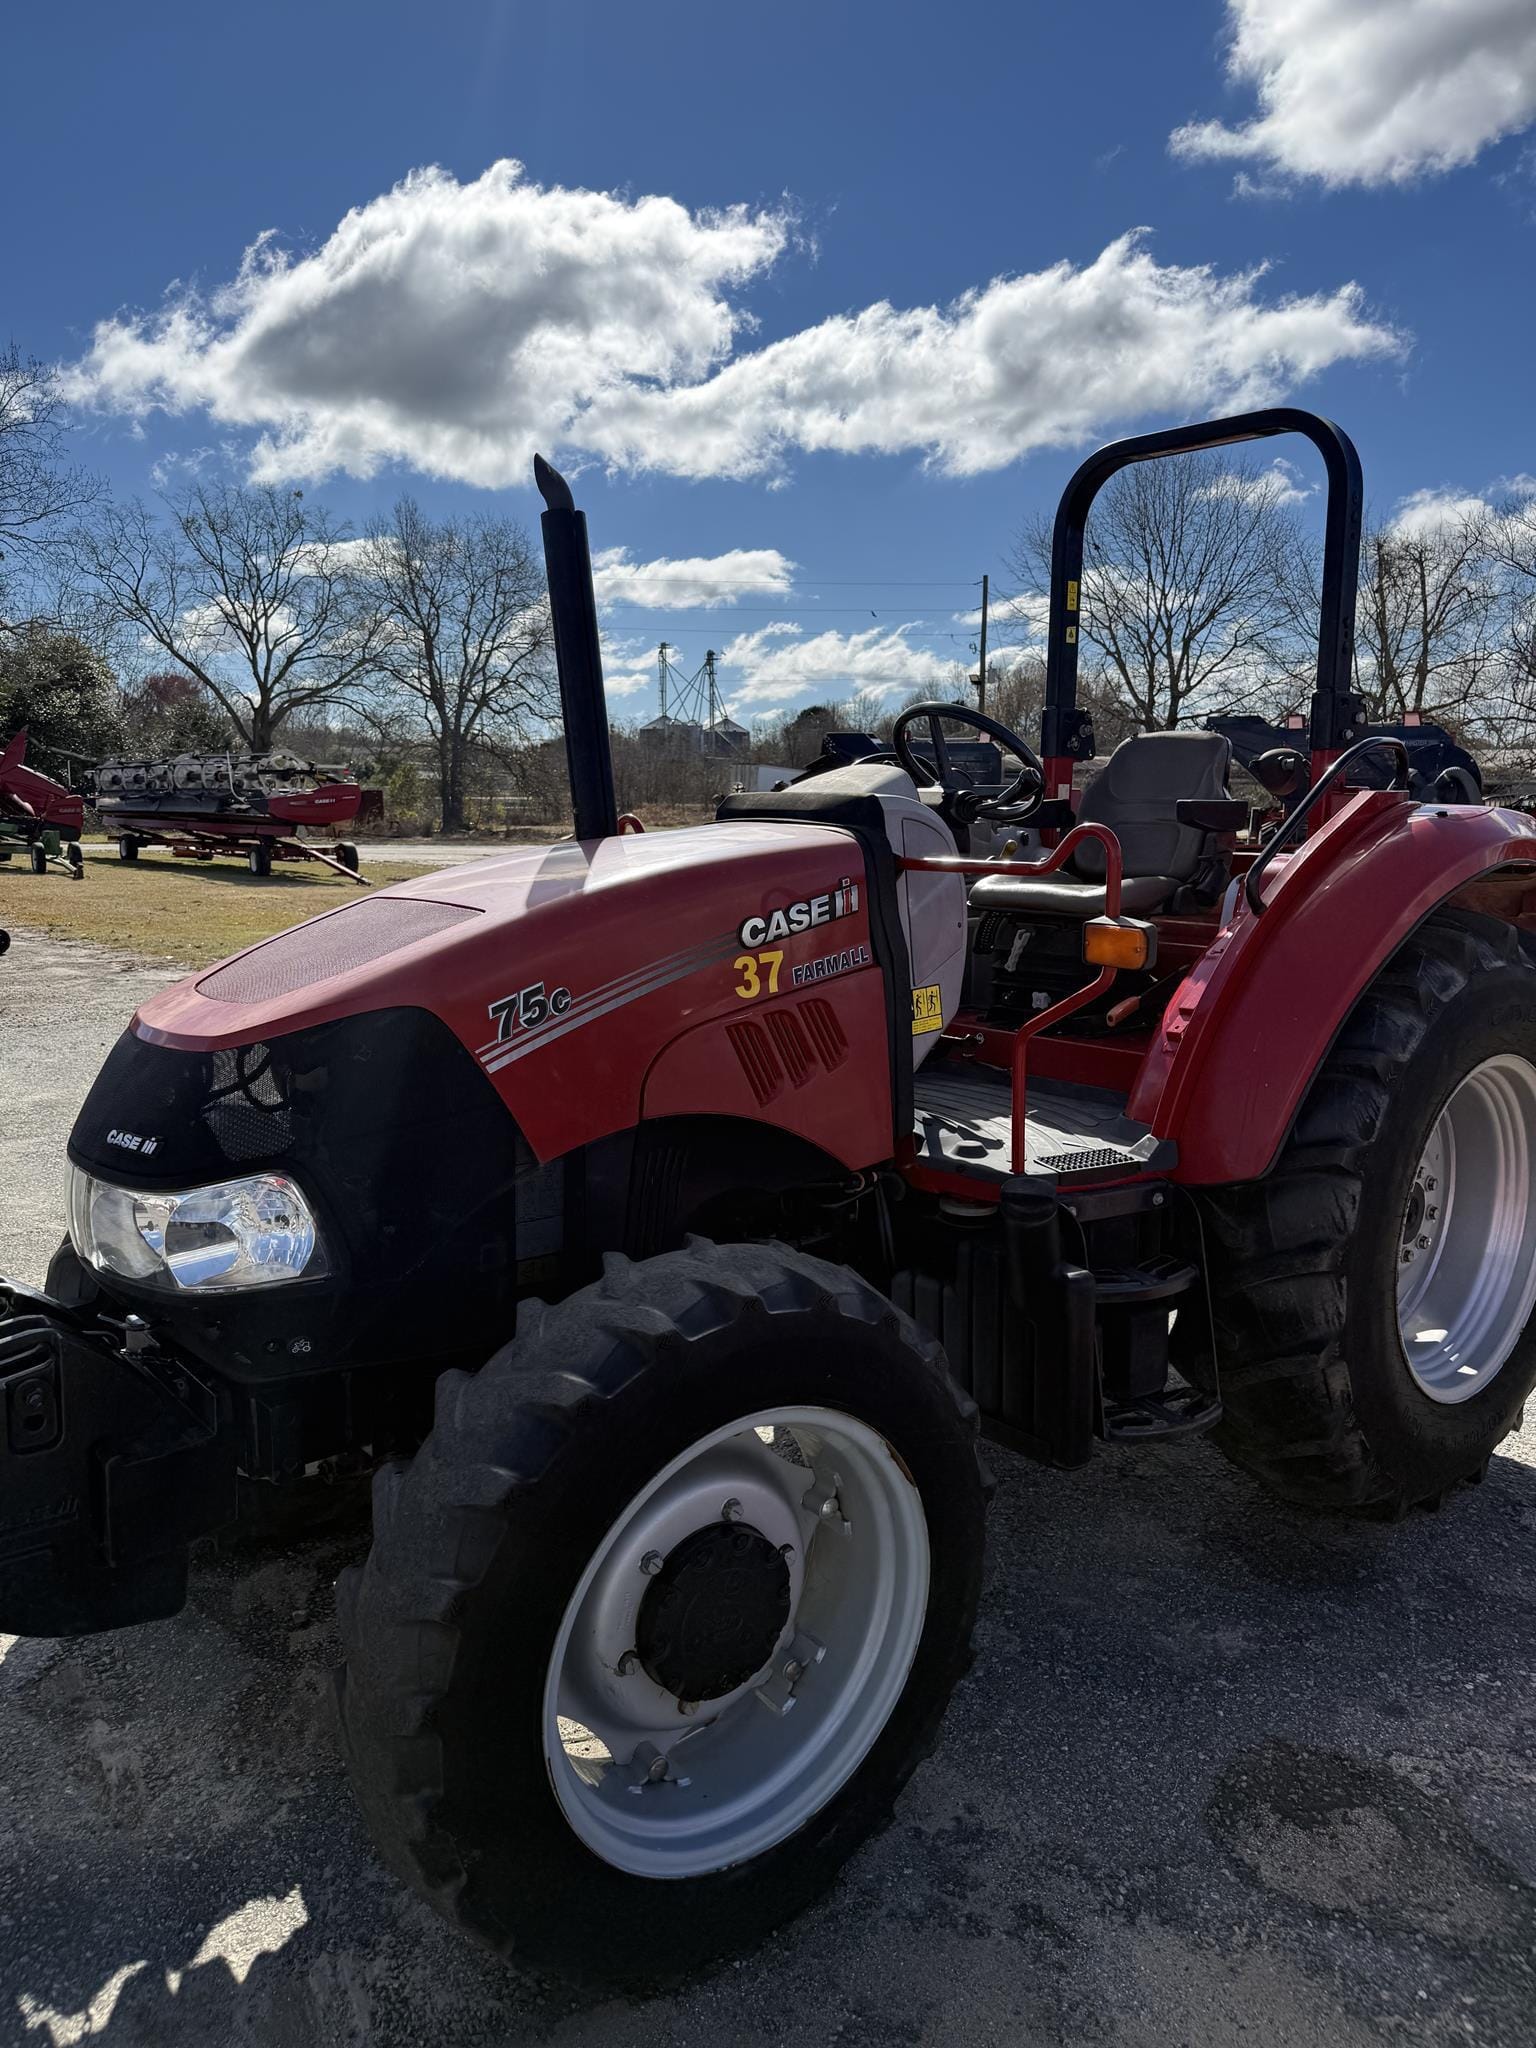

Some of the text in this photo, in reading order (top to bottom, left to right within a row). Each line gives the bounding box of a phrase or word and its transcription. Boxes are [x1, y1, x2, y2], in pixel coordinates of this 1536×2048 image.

[741, 894, 830, 948] CASE
[733, 950, 784, 999] 37
[792, 946, 871, 985] FARMALL
[106, 1129, 143, 1151] CASE
